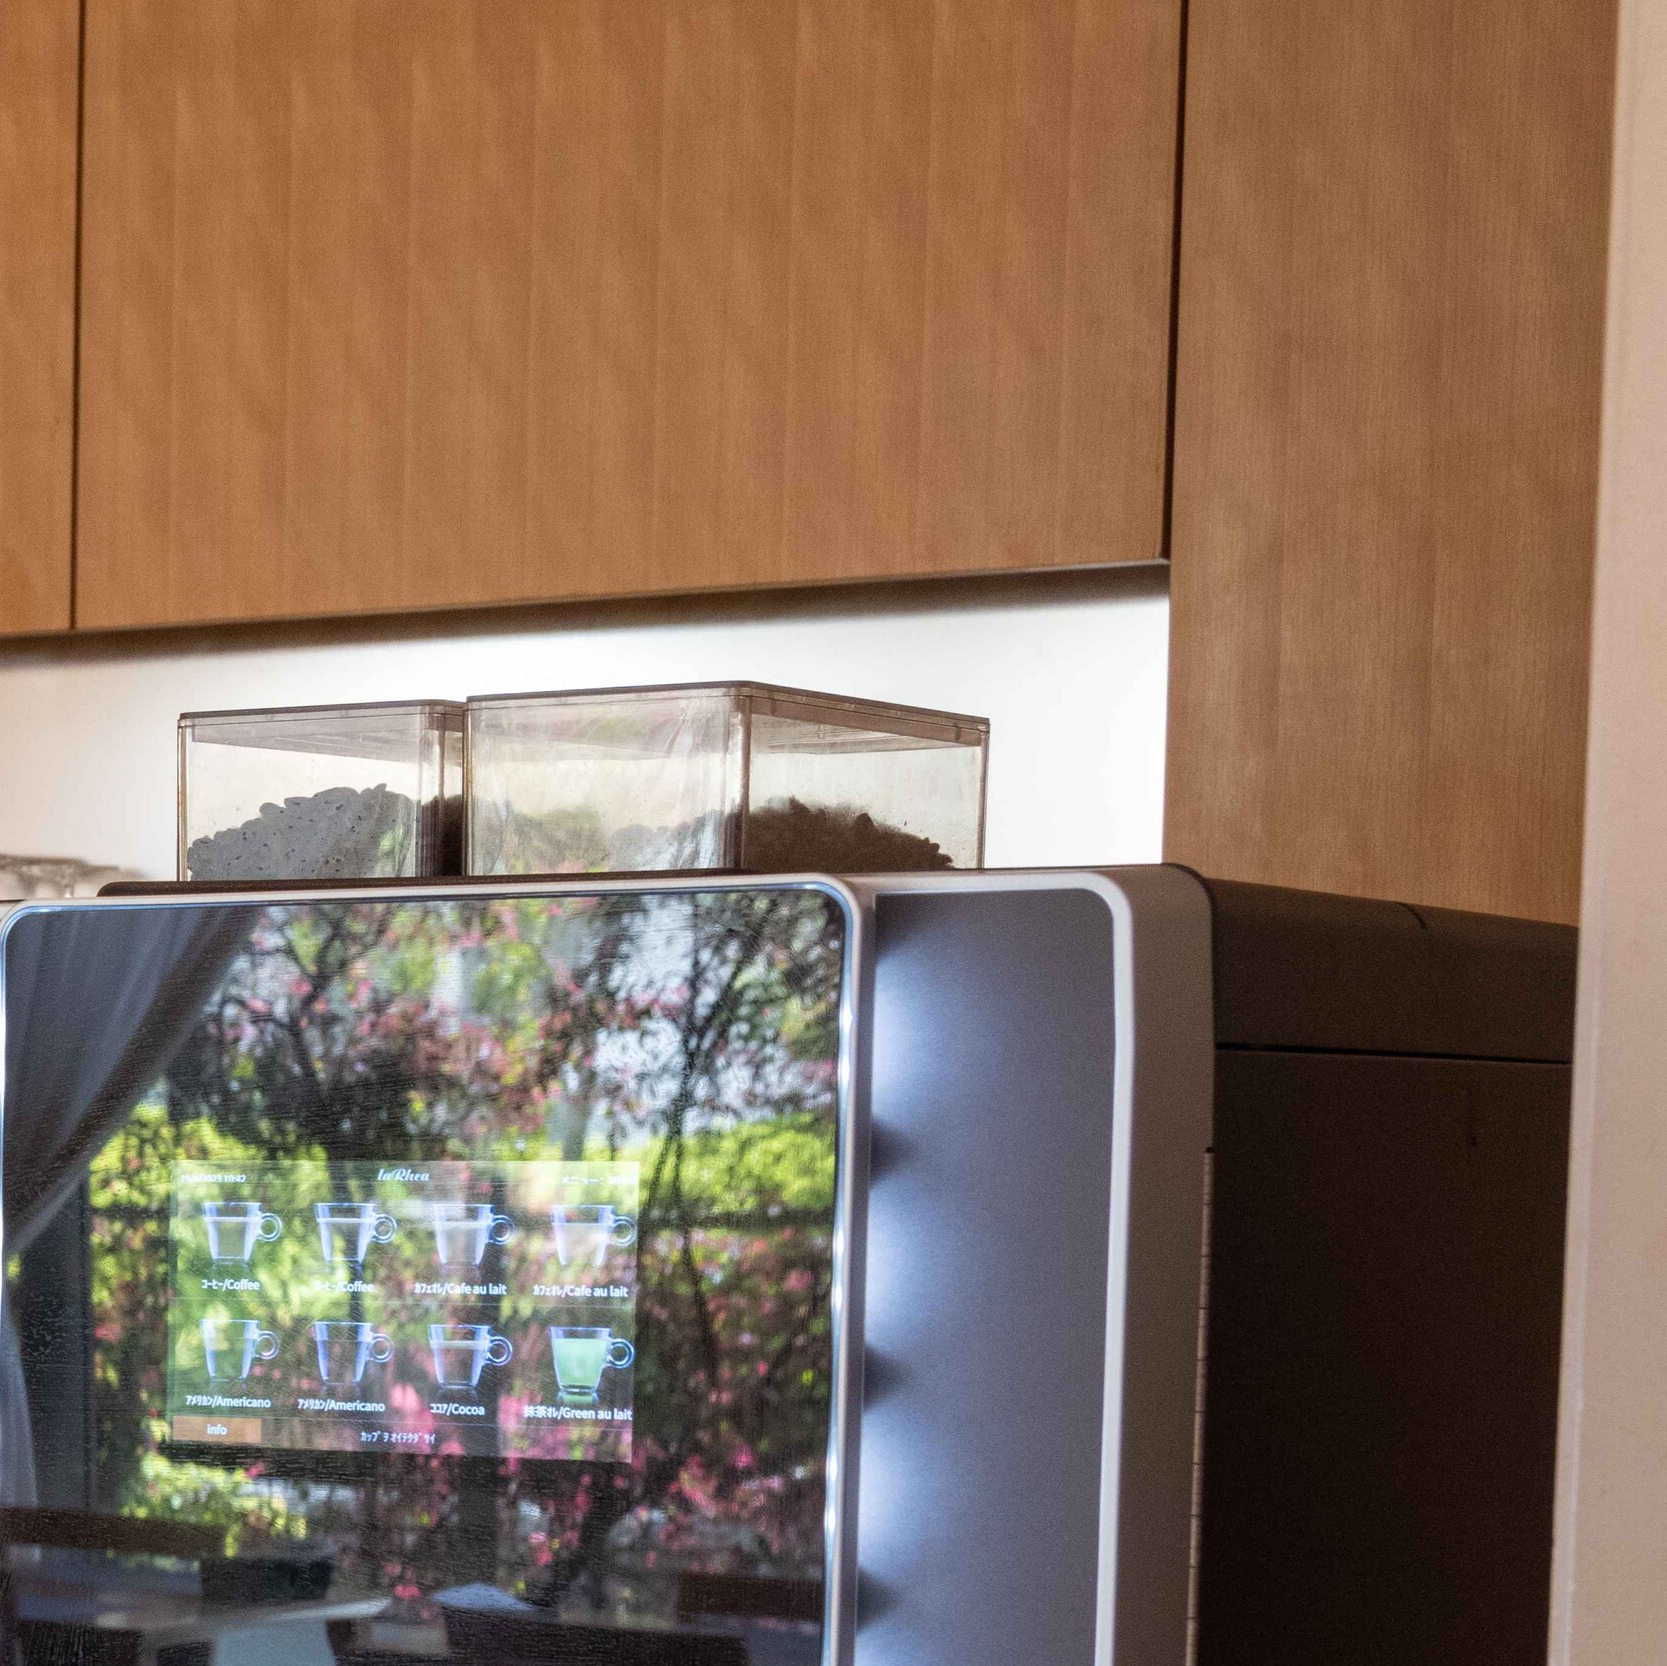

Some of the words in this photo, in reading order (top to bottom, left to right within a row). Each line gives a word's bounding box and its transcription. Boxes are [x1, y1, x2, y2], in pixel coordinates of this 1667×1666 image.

[377, 1167, 430, 1182] laRhea
[473, 1286, 487, 1295] au
[488, 1283, 507, 1295] lait
[593, 1287, 608, 1297] au
[609, 1285, 629, 1297] lait
[597, 1410, 612, 1420] au
[613, 1408, 633, 1421] lait
[207, 1424, 227, 1435] info
